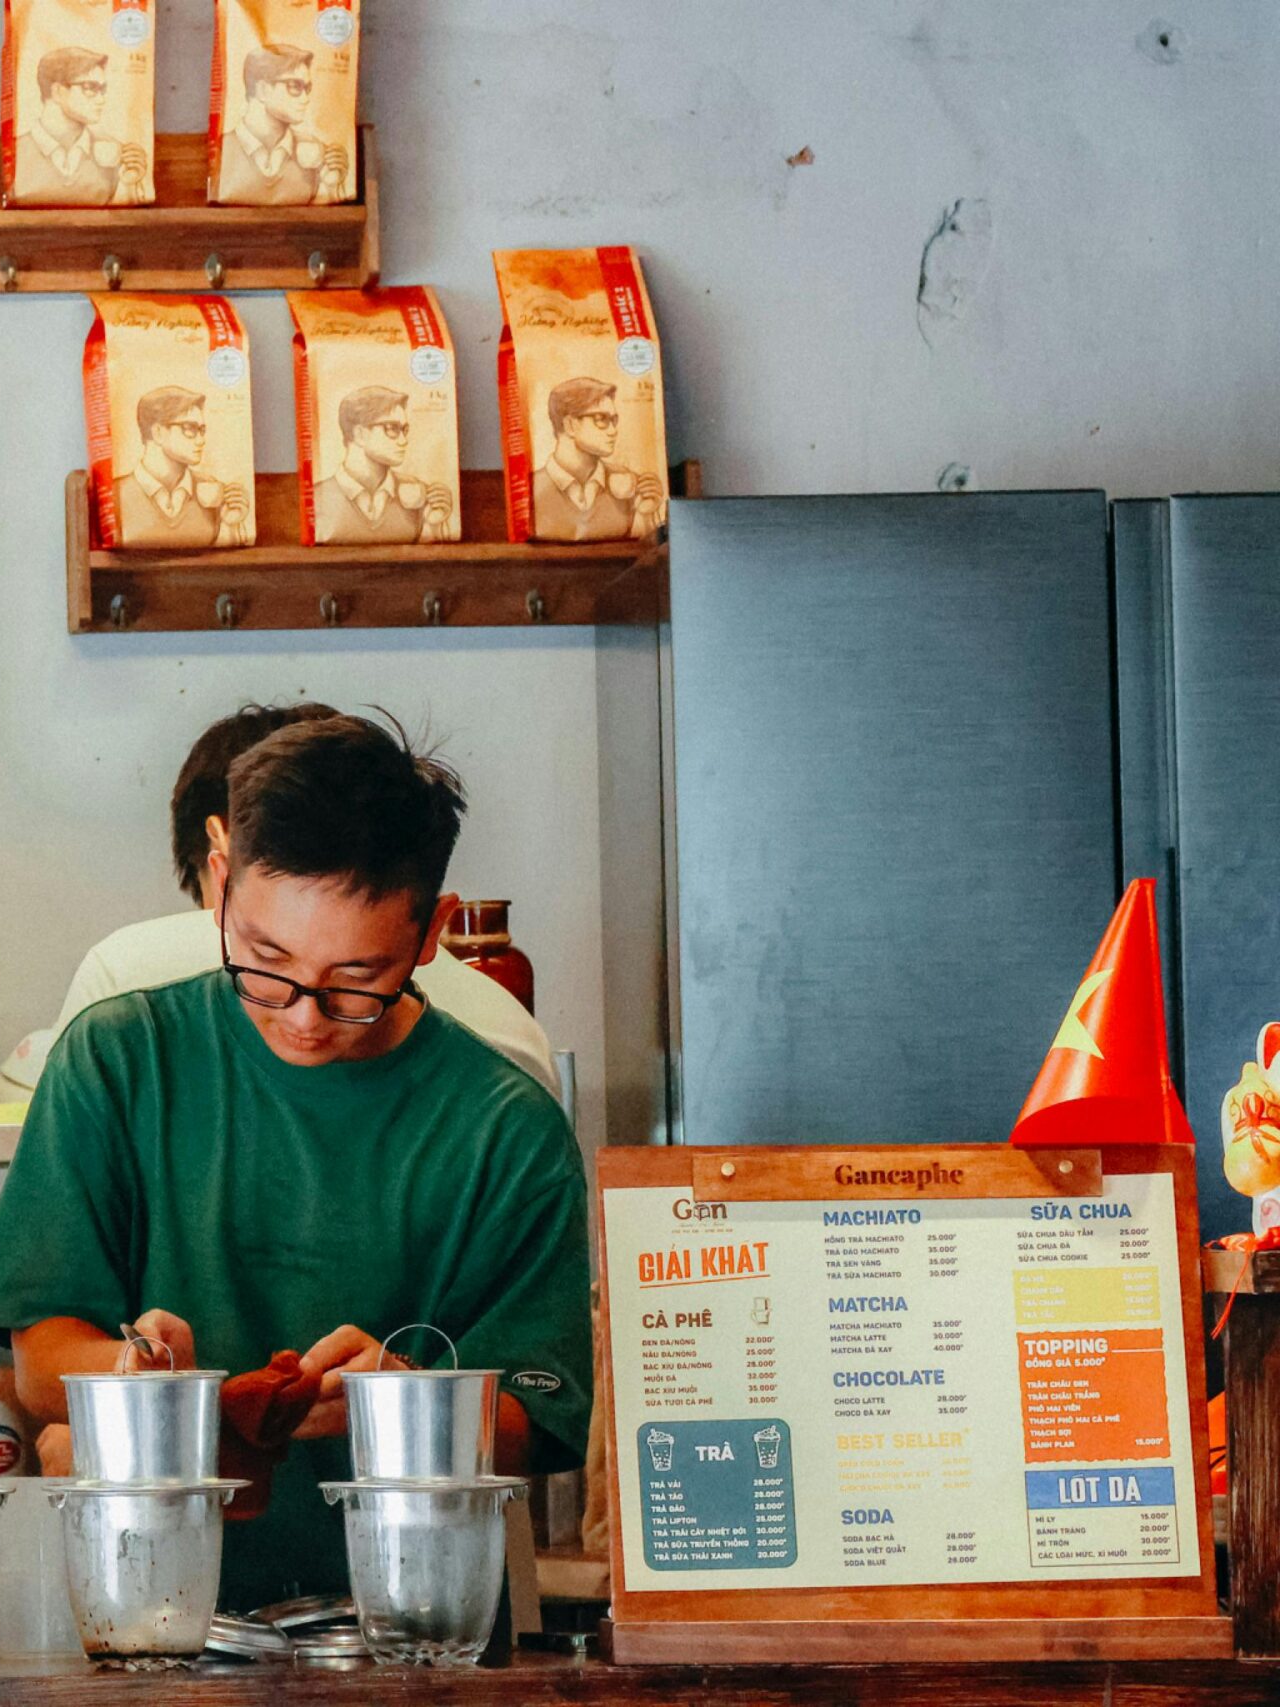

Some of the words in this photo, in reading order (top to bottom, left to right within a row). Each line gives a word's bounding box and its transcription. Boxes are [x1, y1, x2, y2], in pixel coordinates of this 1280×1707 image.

[834, 1162, 964, 1191] Gancaphe
[824, 1209, 921, 1226] MACHIATO
[1031, 1202, 1072, 1220] SỮA
[1080, 1203, 1132, 1219] CHUA
[829, 1297, 908, 1312] MATCHA
[642, 1310, 669, 1329] CÀ
[676, 1309, 713, 1328] PHÊ
[864, 1334, 886, 1342] LATTE
[1024, 1338, 1108, 1355] TOPPING
[833, 1369, 945, 1387] CHOCOLATE
[837, 1434, 885, 1450] BEST
[893, 1432, 962, 1448] SELLER
[695, 1442, 735, 1462] TRÀ
[841, 1509, 894, 1525] SODA
